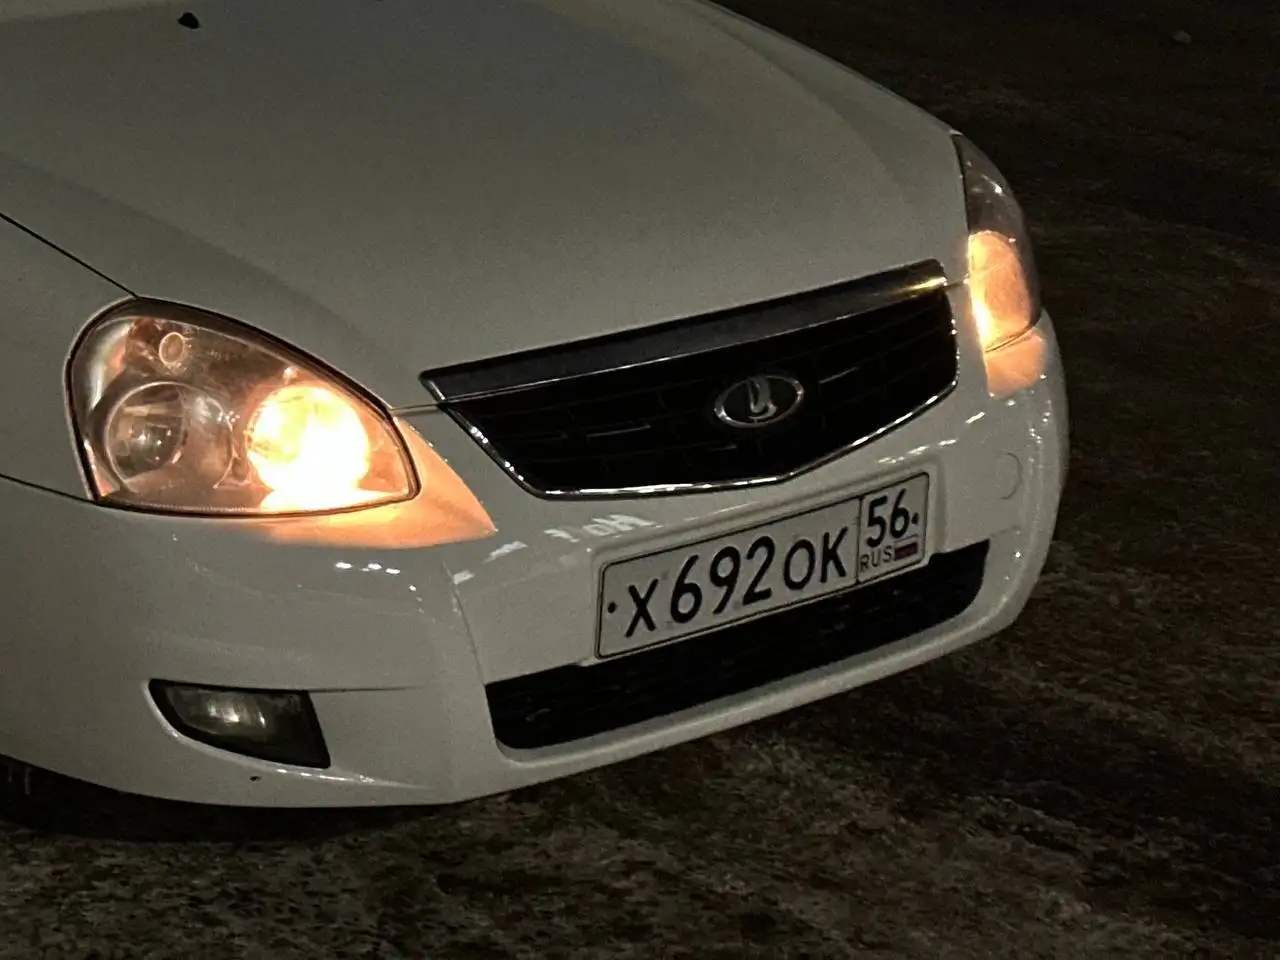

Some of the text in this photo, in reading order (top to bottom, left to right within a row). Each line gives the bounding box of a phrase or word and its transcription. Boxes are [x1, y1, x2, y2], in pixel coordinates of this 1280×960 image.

[623, 488, 910, 638] Х692ОК 56
[858, 544, 893, 572] RUS
